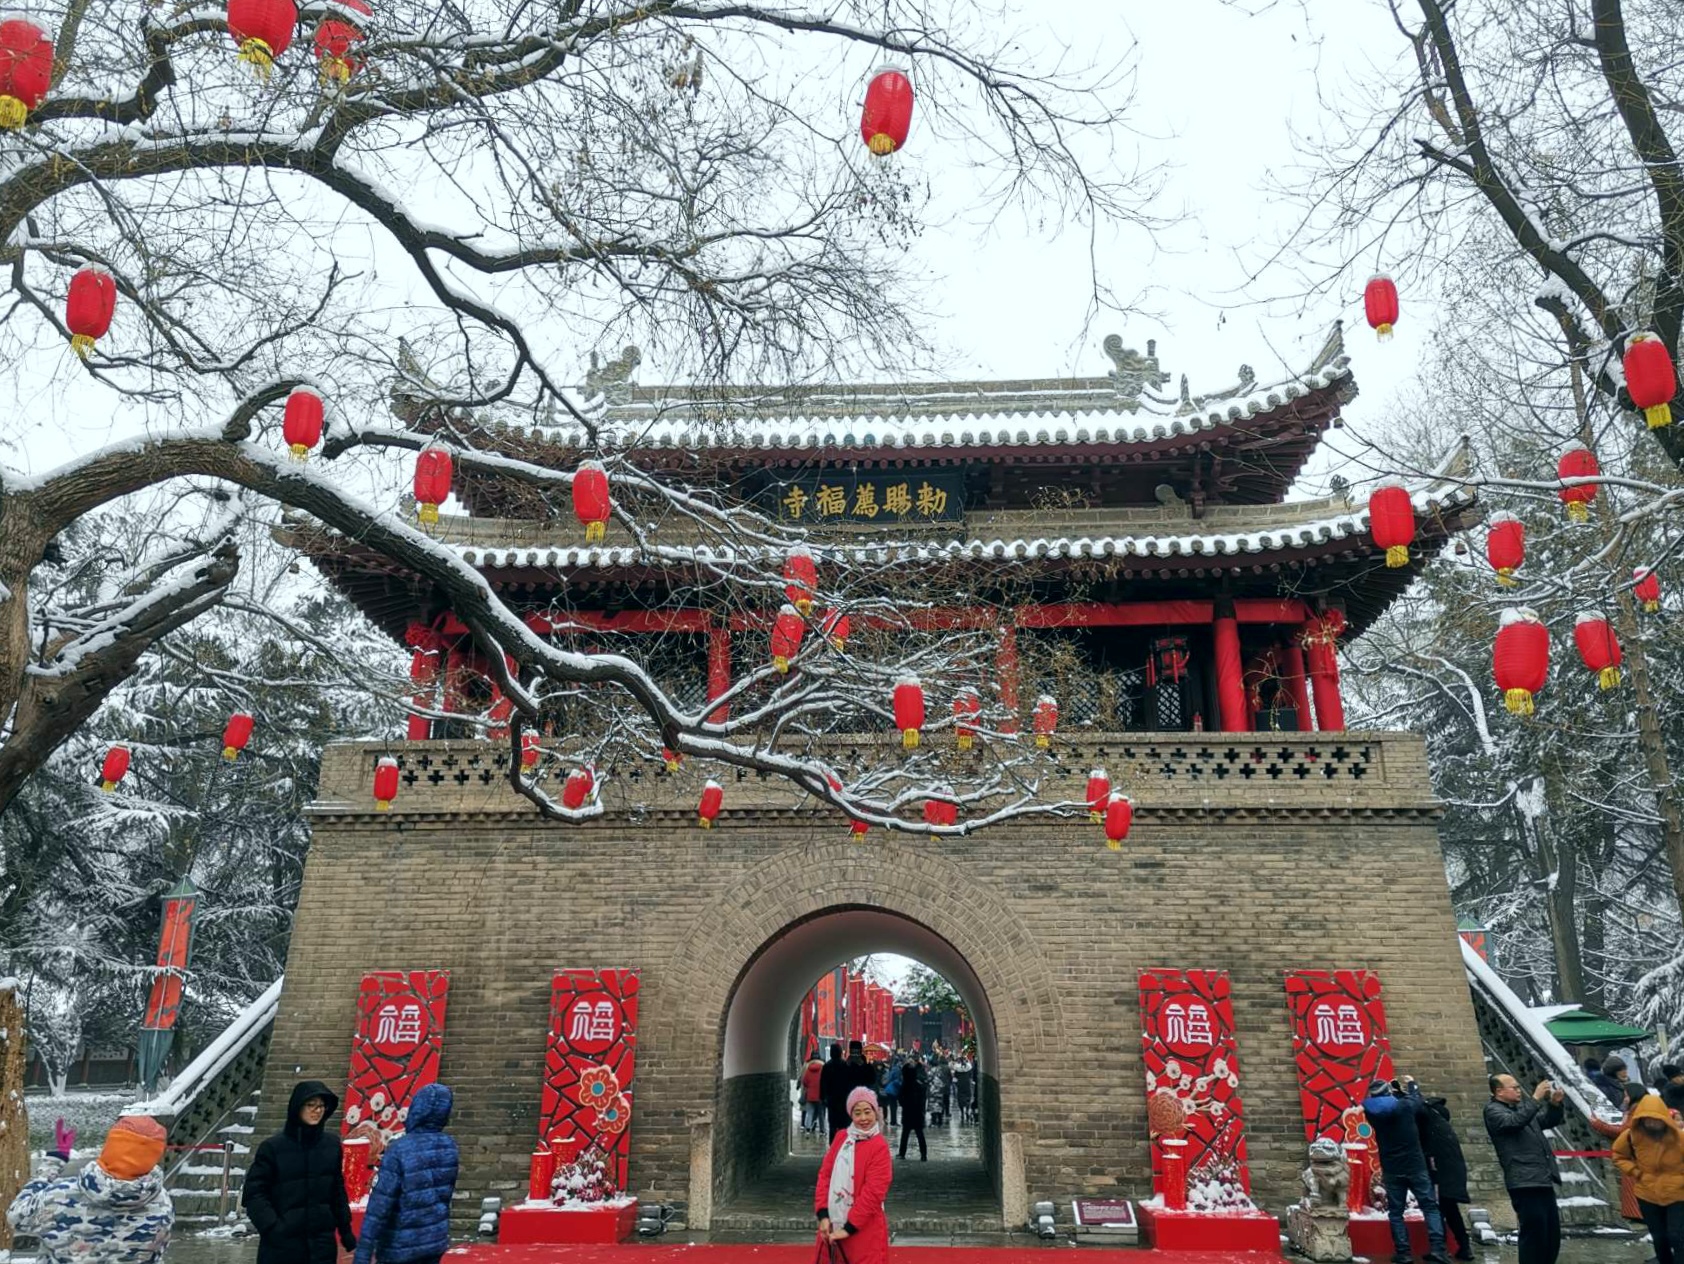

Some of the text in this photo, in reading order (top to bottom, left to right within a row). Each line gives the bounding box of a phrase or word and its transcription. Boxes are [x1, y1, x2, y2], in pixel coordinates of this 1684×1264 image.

[375, 1004, 421, 1044] 福
[569, 1001, 615, 1042] 福
[1166, 1003, 1213, 1046] 福
[1315, 1004, 1364, 1046] 福
